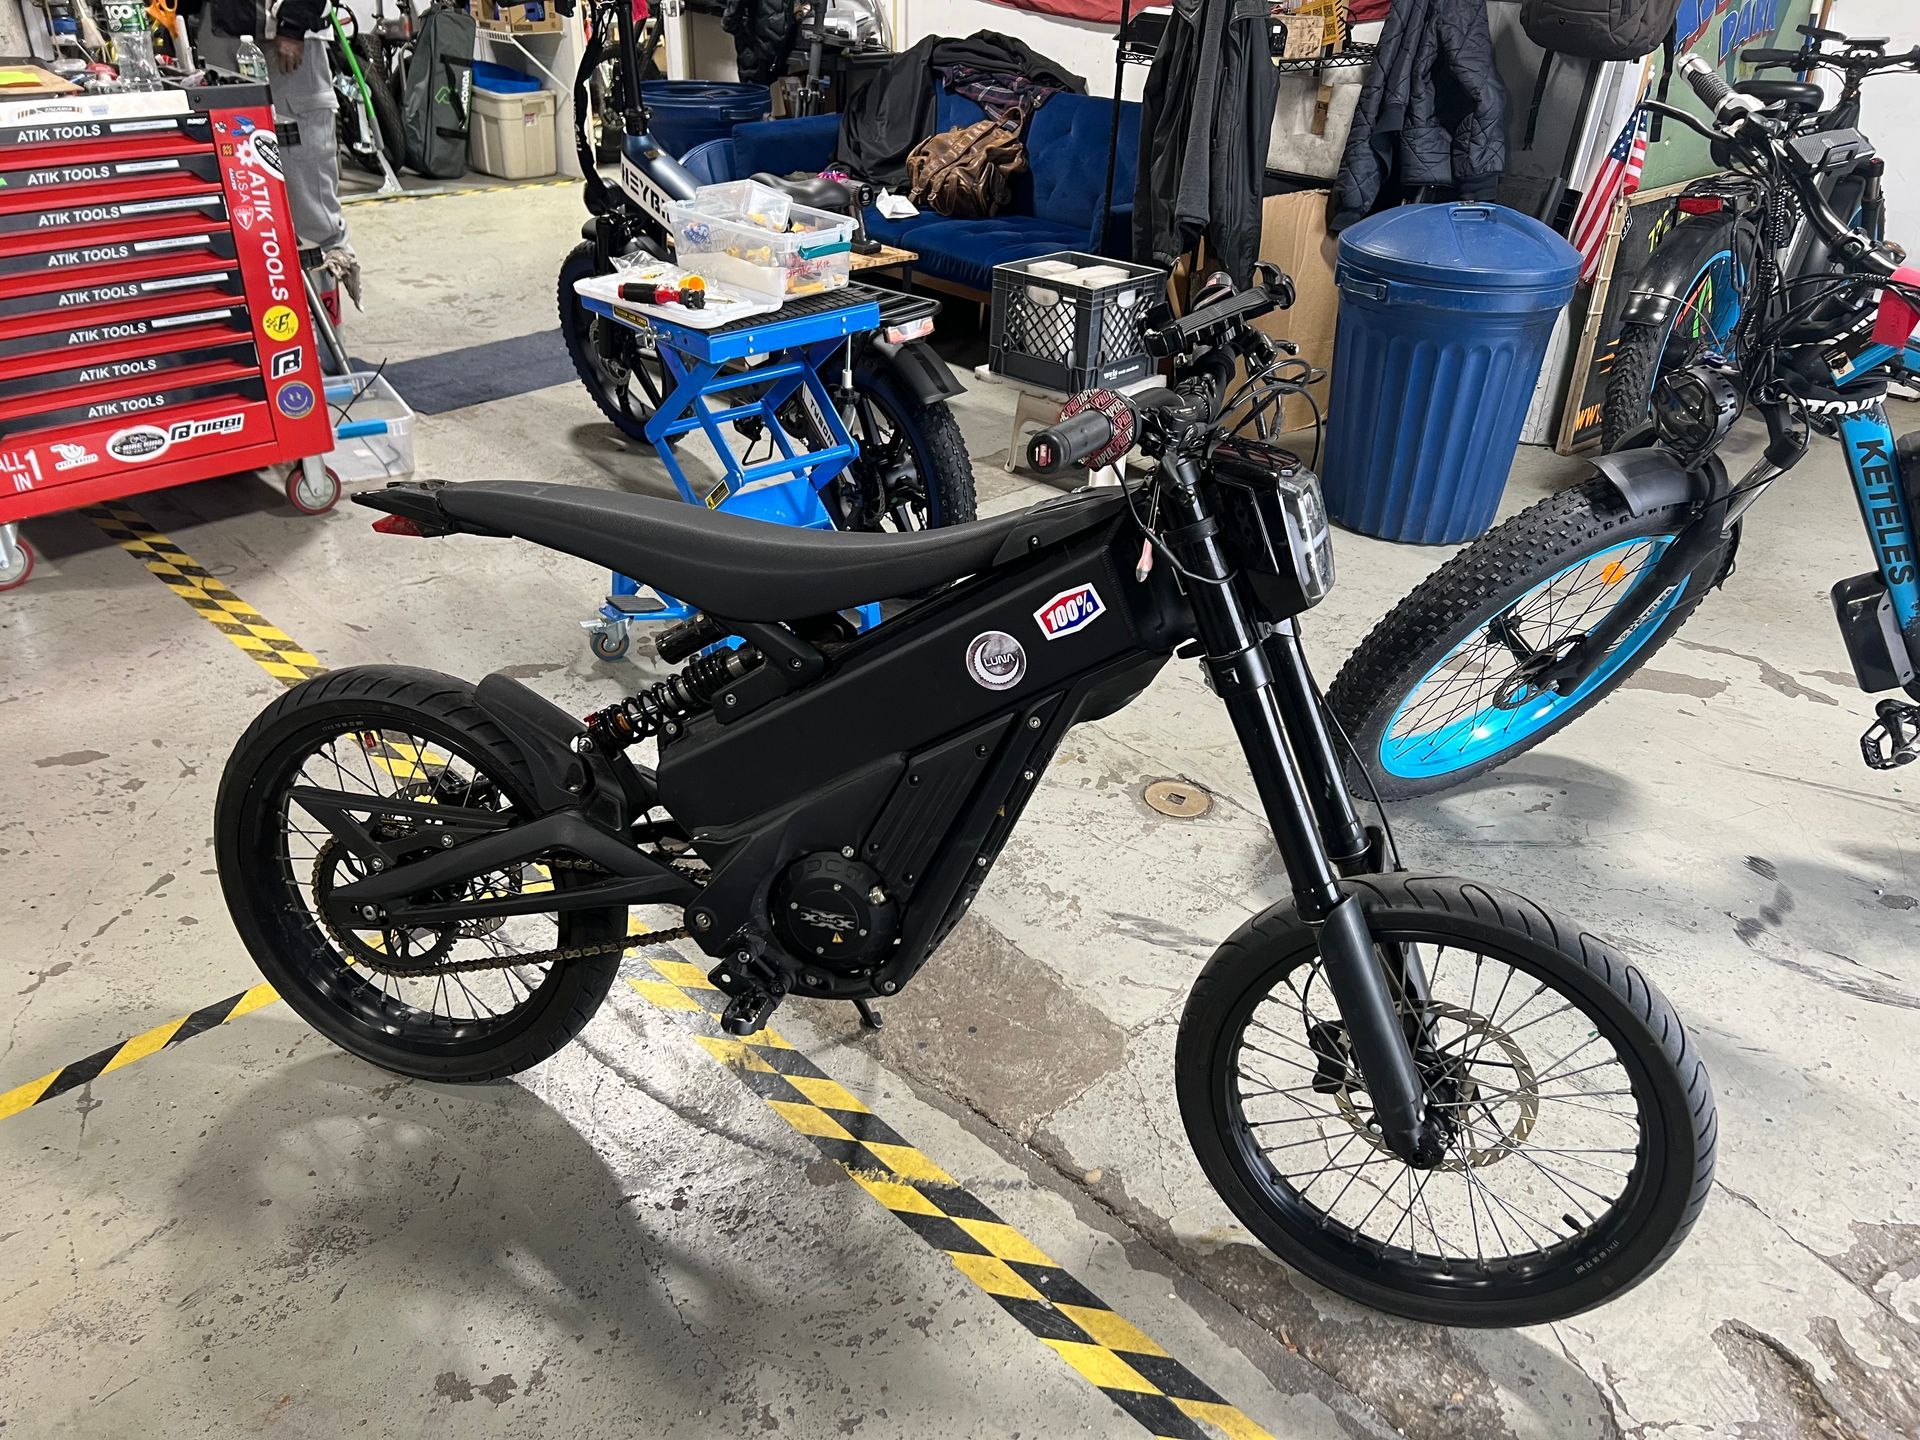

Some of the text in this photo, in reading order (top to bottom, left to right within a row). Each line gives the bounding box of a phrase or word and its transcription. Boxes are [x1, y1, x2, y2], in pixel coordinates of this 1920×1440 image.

[17, 123, 101, 143] ATIK TOOLS
[27, 165, 110, 186] ATIK TOOLS
[248, 170, 275, 222] ATIK
[38, 205, 120, 227] ATIK TOOLS
[48, 246, 129, 267] ATIK TOOLS
[260, 227, 289, 301] TOOLS
[58, 284, 138, 306] ATIK TOOLS
[68, 322, 147, 345] ATIK TOOLS
[79, 359, 157, 382] ATIK TOOLS
[88, 394, 165, 418] ATIK TOOLS
[1067, 400, 1080, 417] PRO
[194, 416, 242, 434] NIBBI
[810, 399, 835, 446] TYSON
[1117, 411, 1132, 428] PRO
[24, 449, 43, 480] 1
[12, 472, 34, 492] IN
[1856, 439, 1915, 585] KETELES
[1046, 591, 1094, 631] 100%
[983, 653, 1016, 667] LUNA
